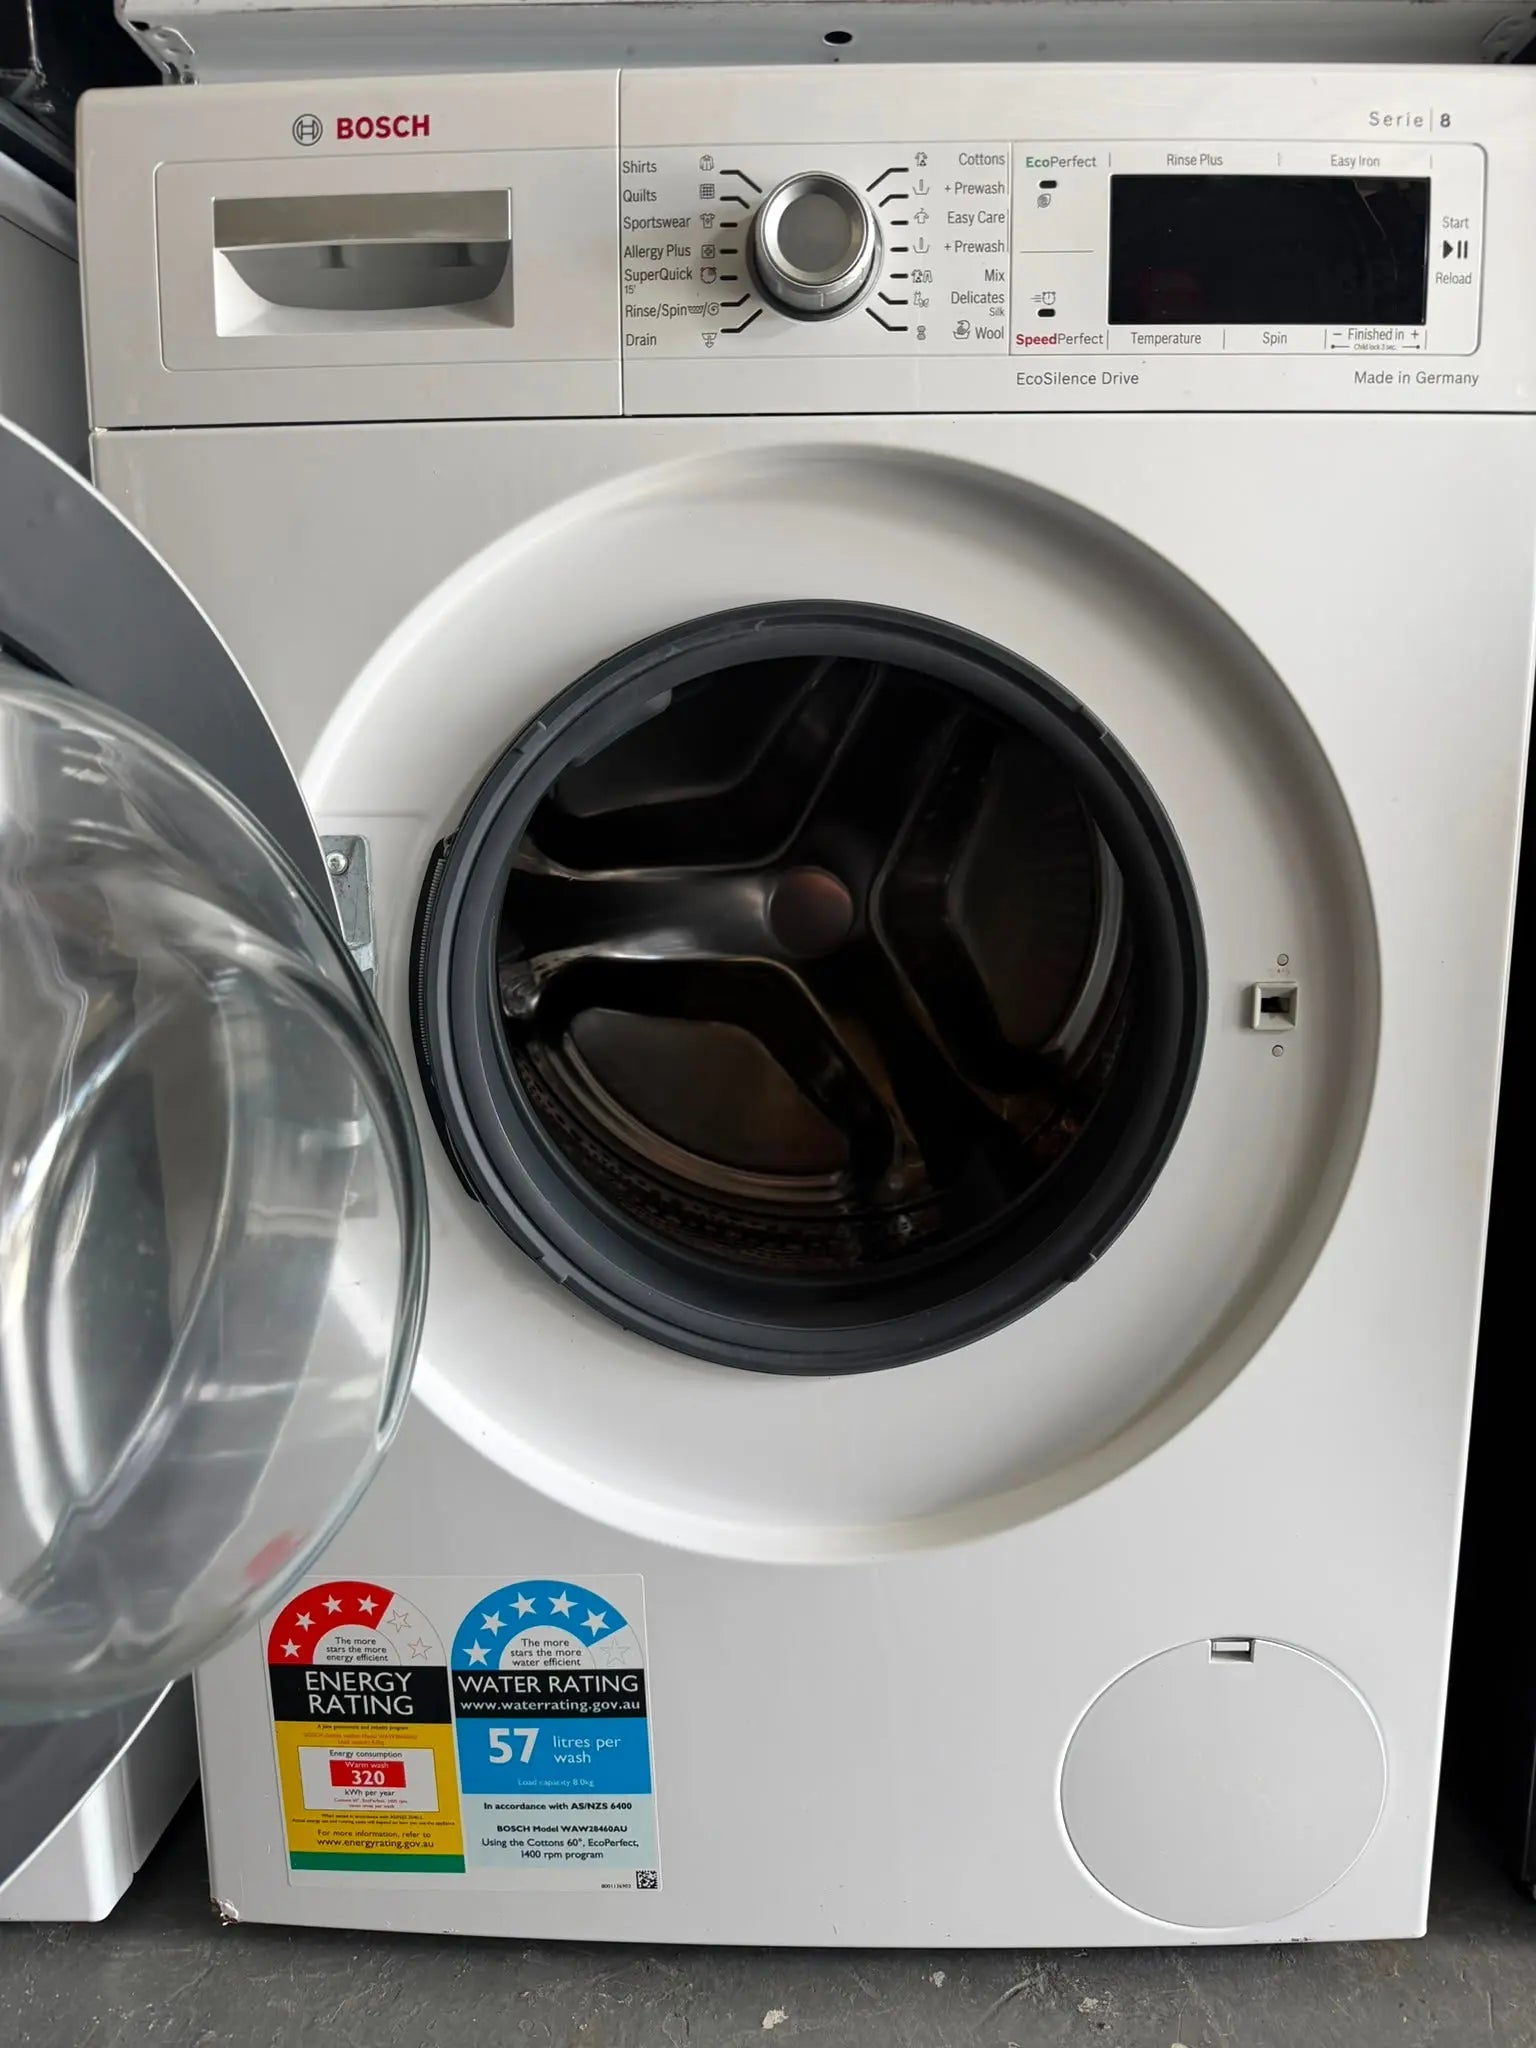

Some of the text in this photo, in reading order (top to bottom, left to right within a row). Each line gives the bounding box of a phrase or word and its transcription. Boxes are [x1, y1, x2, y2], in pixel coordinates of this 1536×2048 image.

[1368, 111, 1451, 128] Serie 8
[337, 114, 430, 140] BOSCH
[958, 153, 1006, 166] Cottons
[1026, 156, 1097, 168] EcoPerfect
[1166, 153, 1224, 166] Rinse Plus
[1330, 154, 1380, 169] Easy Iron
[622, 160, 657, 174] Shirts
[954, 182, 1005, 195] Prewash
[623, 189, 657, 203] Quilts
[624, 216, 691, 231] Sportswear
[947, 210, 1006, 226] Easy Care
[1442, 216, 1470, 230] Start
[624, 244, 691, 260] Allergy Plus
[954, 240, 1005, 253] Prewash
[624, 267, 692, 284] SuperQuick
[984, 270, 1005, 282] Mix
[1435, 272, 1472, 285] Reload
[950, 291, 1005, 304] Delicates
[625, 304, 688, 319] Rinse/Spin
[988, 307, 1005, 317] Silk
[626, 334, 657, 346] Drain
[975, 327, 1004, 340] Wool
[1130, 332, 1202, 347] Temperature
[1262, 331, 1288, 347] Spin
[1348, 328, 1392, 340] Finished
[1395, 328, 1404, 340] in
[1016, 334, 1104, 347] SpeedPerfect
[1016, 372, 1139, 386] EcoSilence Drive
[1354, 370, 1479, 387] Made in Germany
[335, 1636, 352, 1645] The
[521, 1638, 540, 1647] The
[326, 1646, 387, 1654] stars the more
[510, 1649, 534, 1657] stars
[536, 1648, 552, 1656] the
[326, 1654, 388, 1663] energy efficient
[512, 1658, 581, 1667] water efficient
[305, 1671, 413, 1692] ENERGY
[458, 1675, 639, 1694] WATER RATING
[308, 1694, 414, 1716] RATING
[460, 1699, 640, 1713] www.waterrating.gov.au
[488, 1727, 540, 1764] 57
[553, 1735, 621, 1751] litres per
[329, 1750, 403, 1759] Energy consumption
[554, 1751, 591, 1764] wash
[352, 1770, 385, 1785] 320
[380, 1790, 395, 1798] year
[484, 1802, 632, 1810] In accordance with AS/NZS 6400
[402, 1830, 420, 1838] refer
[317, 1838, 434, 1850] www.energyrating.gov.au
[482, 1838, 508, 1848] Using
[510, 1838, 524, 1847] the
[526, 1838, 564, 1847] Cottons
[588, 1838, 640, 1848] EcoPerfect,
[520, 1850, 604, 1861] 1400 rpm program
